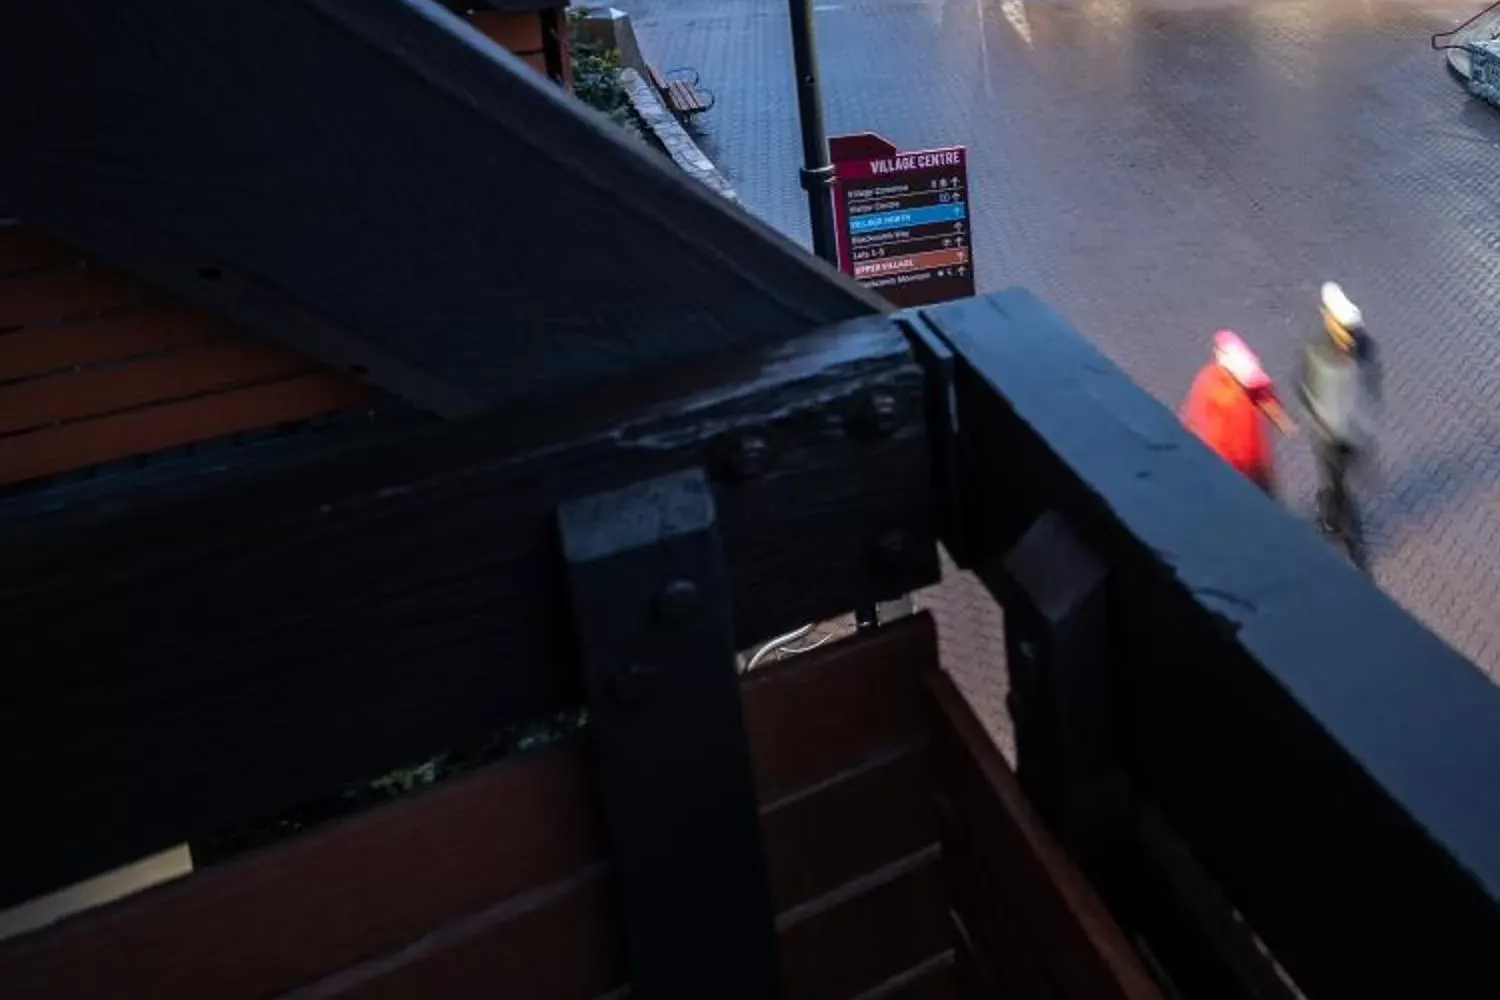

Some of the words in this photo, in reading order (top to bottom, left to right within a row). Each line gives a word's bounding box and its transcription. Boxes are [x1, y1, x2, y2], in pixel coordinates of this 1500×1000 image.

[870, 157, 917, 174] VILLAGE
[918, 151, 960, 168] CENTRE
[881, 258, 915, 271] VILLAGE
